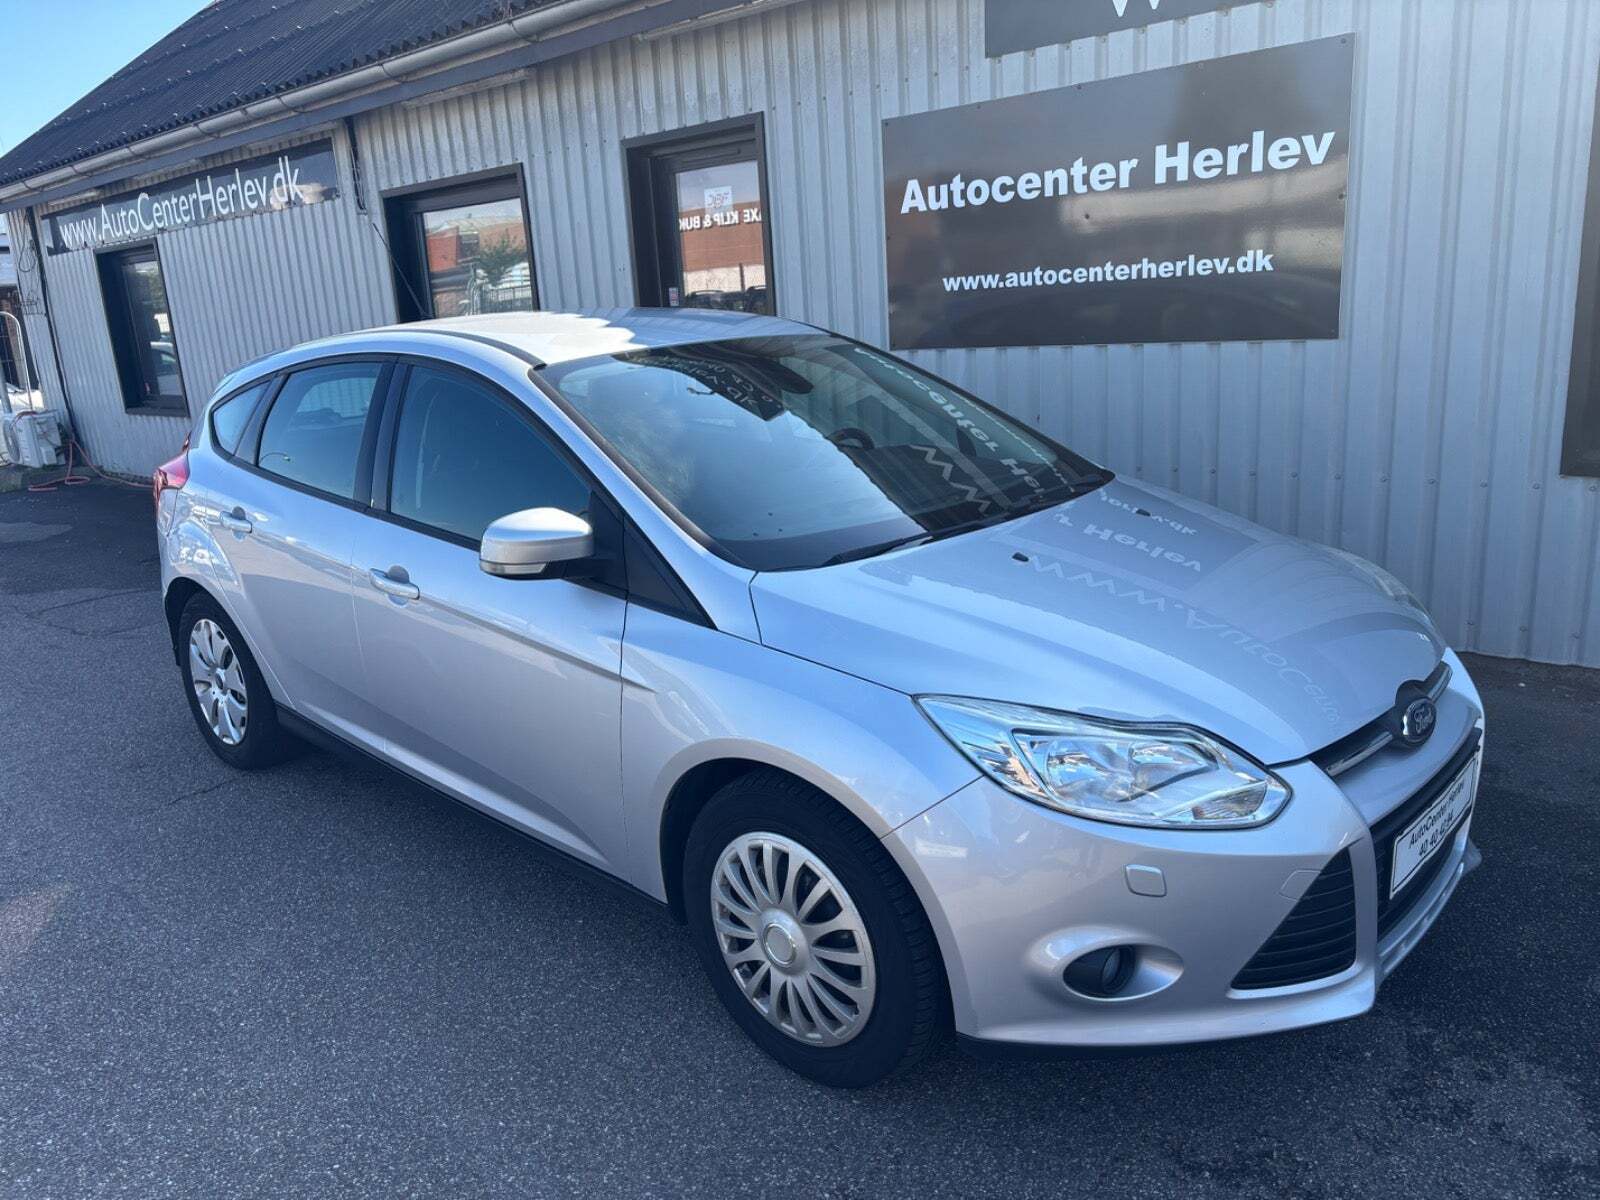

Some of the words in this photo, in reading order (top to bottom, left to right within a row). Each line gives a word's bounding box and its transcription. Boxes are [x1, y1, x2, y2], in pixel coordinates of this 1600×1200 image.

[59, 155, 304, 249] www.AutoCenterHerlev.dk
[900, 156, 1138, 215] Autocenter
[1154, 130, 1336, 185] Herlev
[942, 249, 1275, 293] www.autocenterherlev.dk
